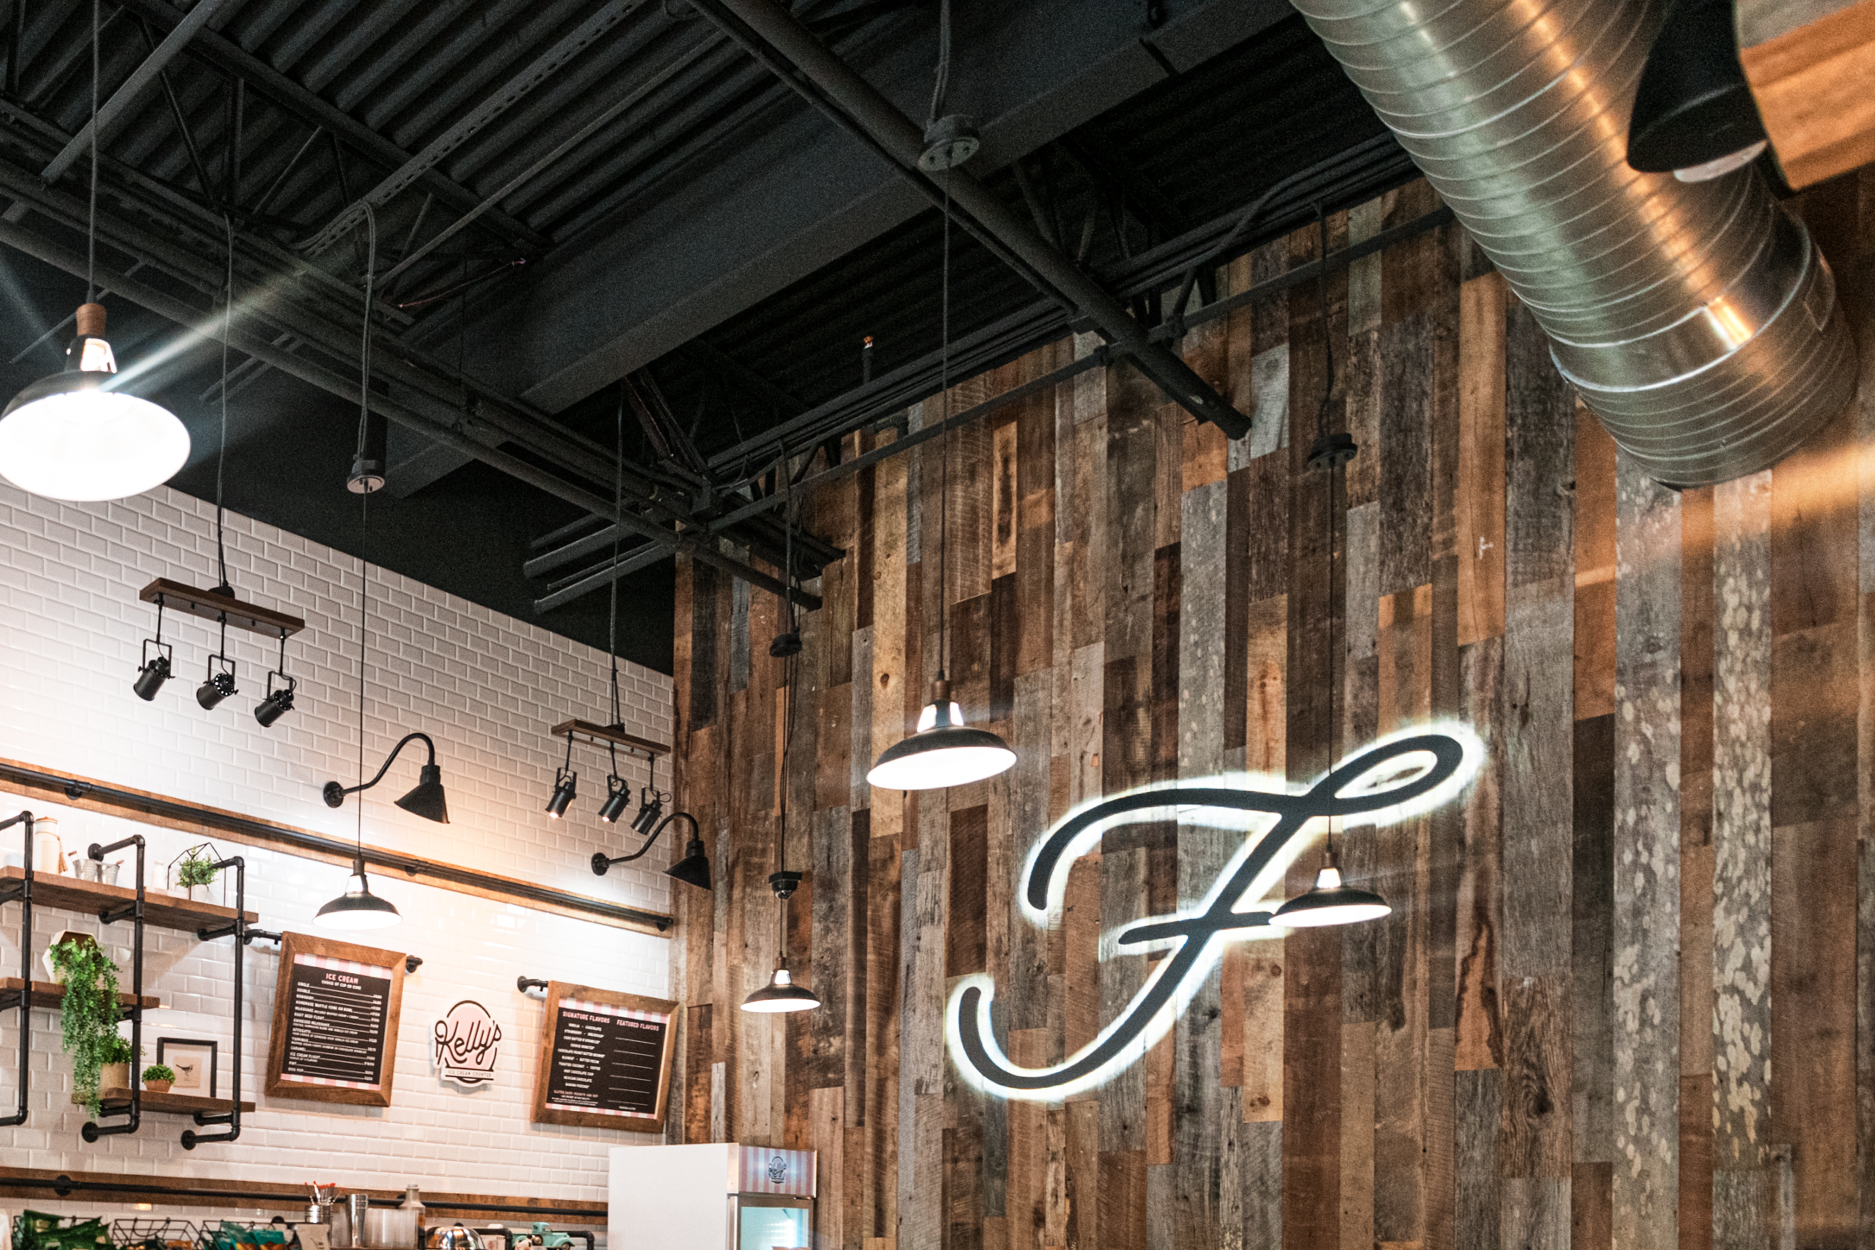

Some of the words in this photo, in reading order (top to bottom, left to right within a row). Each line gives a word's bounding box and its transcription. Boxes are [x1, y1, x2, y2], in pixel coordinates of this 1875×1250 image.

[325, 972, 336, 980] ICE
[338, 974, 359, 985] CREAM
[434, 1019, 502, 1066] Kelly's
